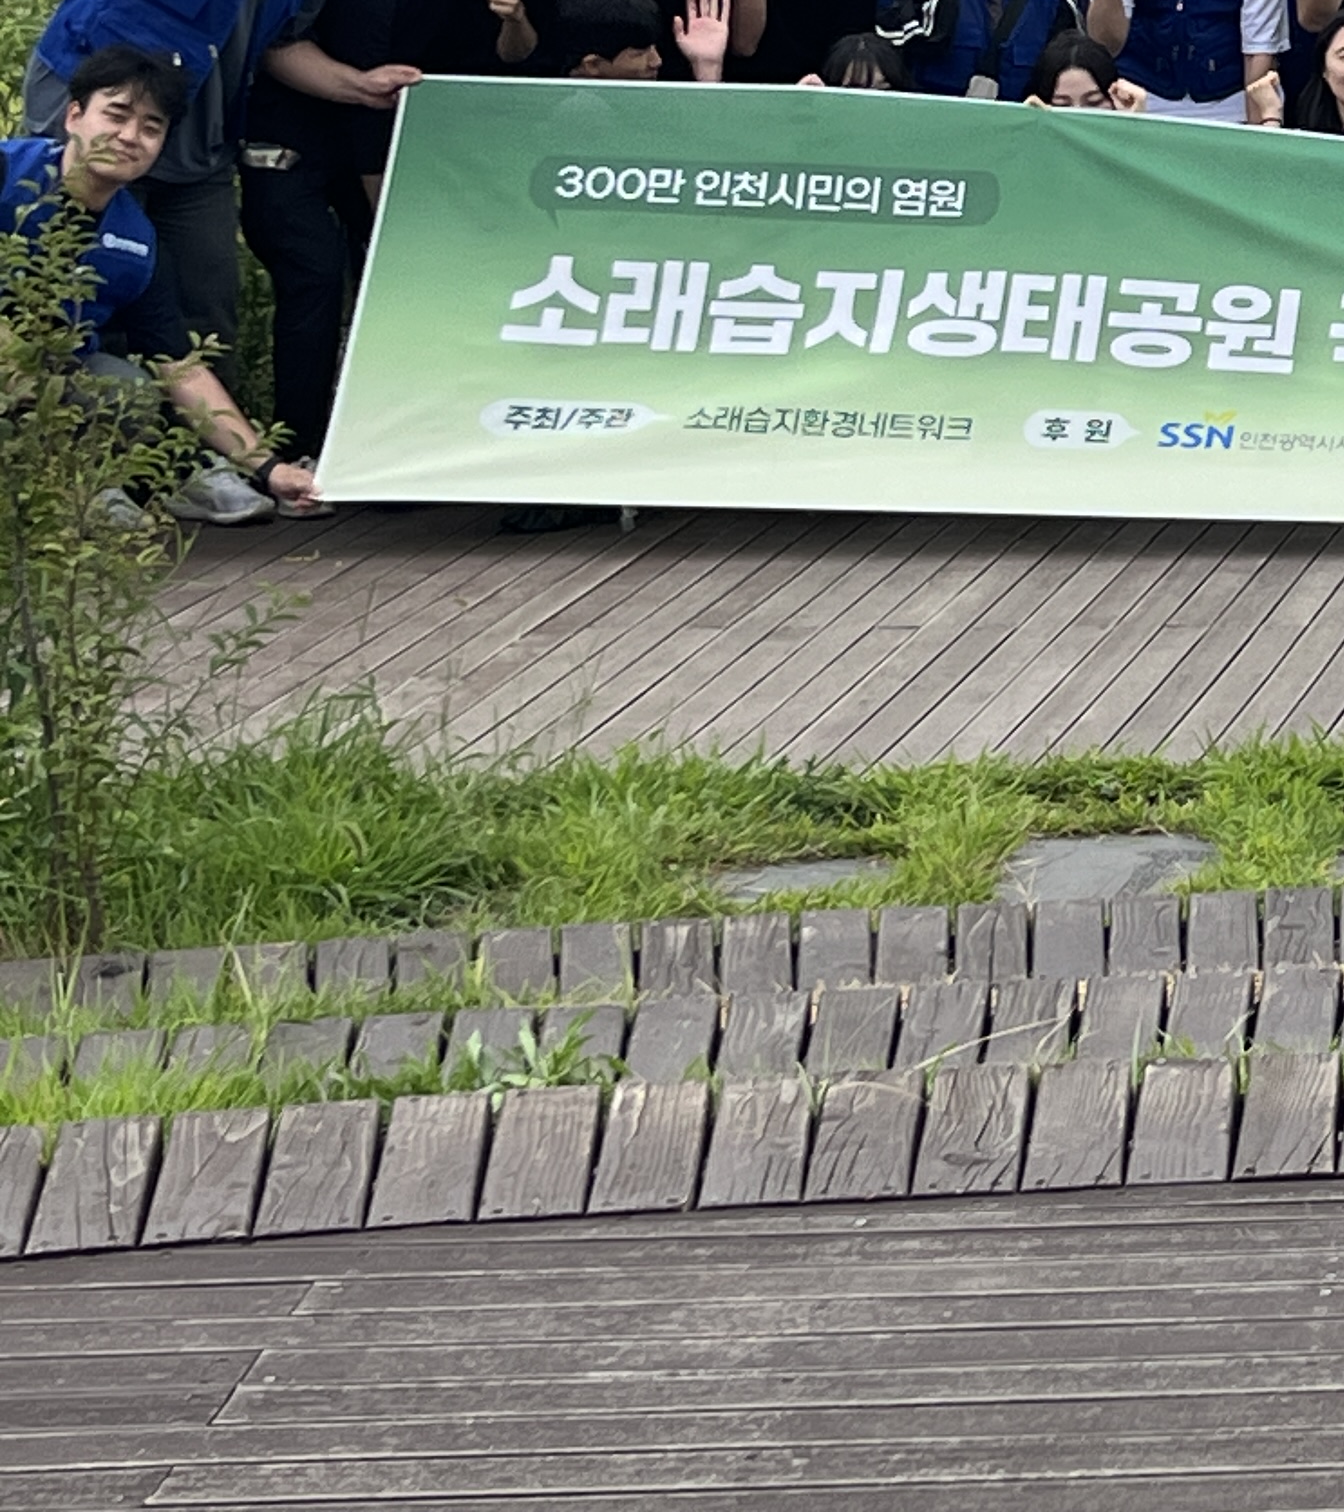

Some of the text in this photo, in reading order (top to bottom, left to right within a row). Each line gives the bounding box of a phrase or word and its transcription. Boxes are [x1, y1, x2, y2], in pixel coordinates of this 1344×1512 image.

[555, 165, 966, 218] 300만 인천시민의 염원
[500, 254, 1301, 375] 소래습지생태공원
[504, 405, 635, 430] 주최/주관
[683, 405, 973, 441] 소래습지환경네트워크
[1157, 422, 1236, 450] SSN
